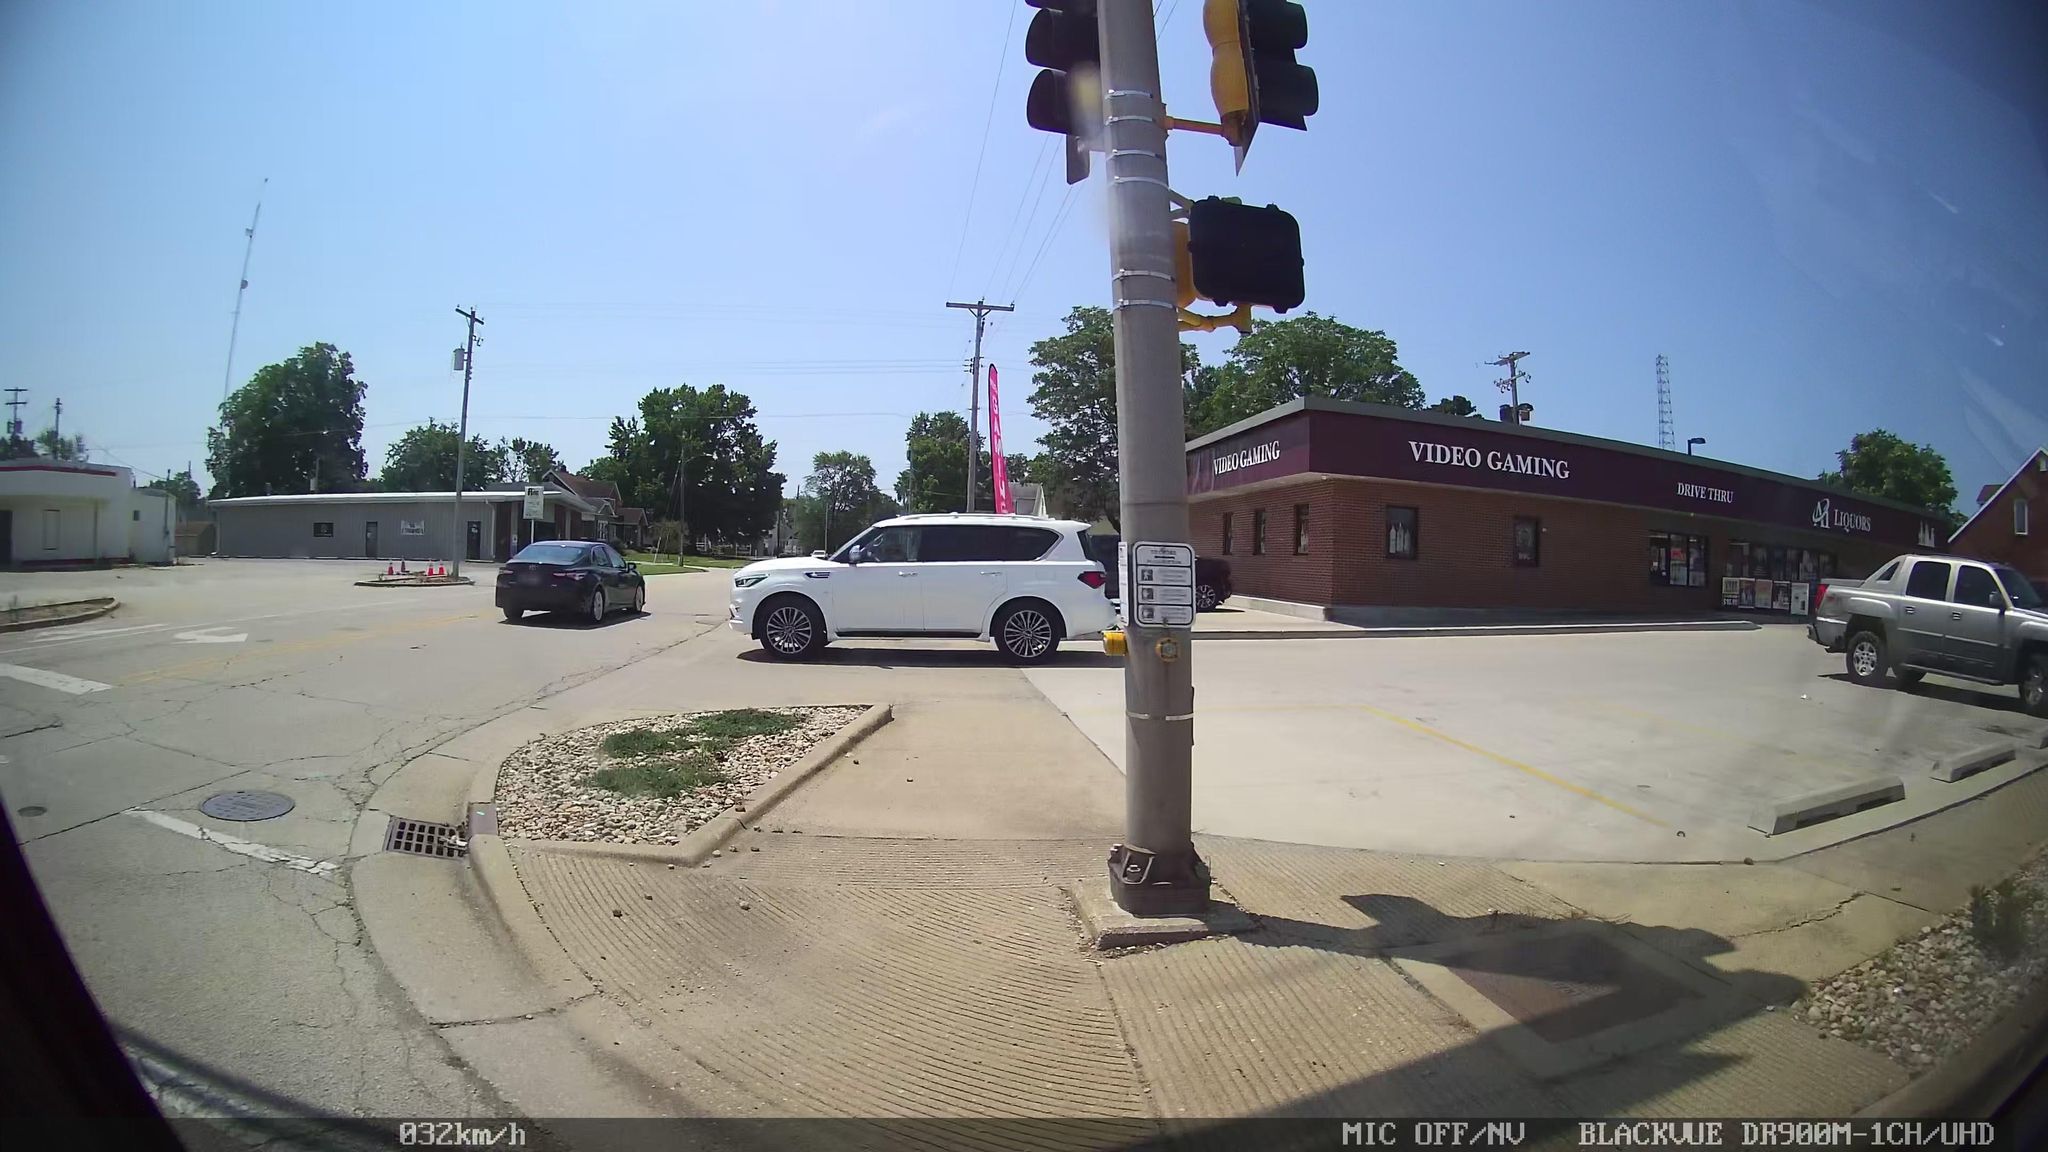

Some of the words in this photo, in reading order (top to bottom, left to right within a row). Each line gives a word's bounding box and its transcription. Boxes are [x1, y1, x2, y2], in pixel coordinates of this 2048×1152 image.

[1213, 452, 1239, 475] VIDEO
[1240, 440, 1281, 468] GAMING
[1408, 440, 1482, 468] VIDEO
[1486, 450, 1571, 479] GAMING
[1677, 482, 1707, 499] DRIVE
[1708, 487, 1734, 503] THRU
[1833, 508, 1872, 533] LIQUORS
